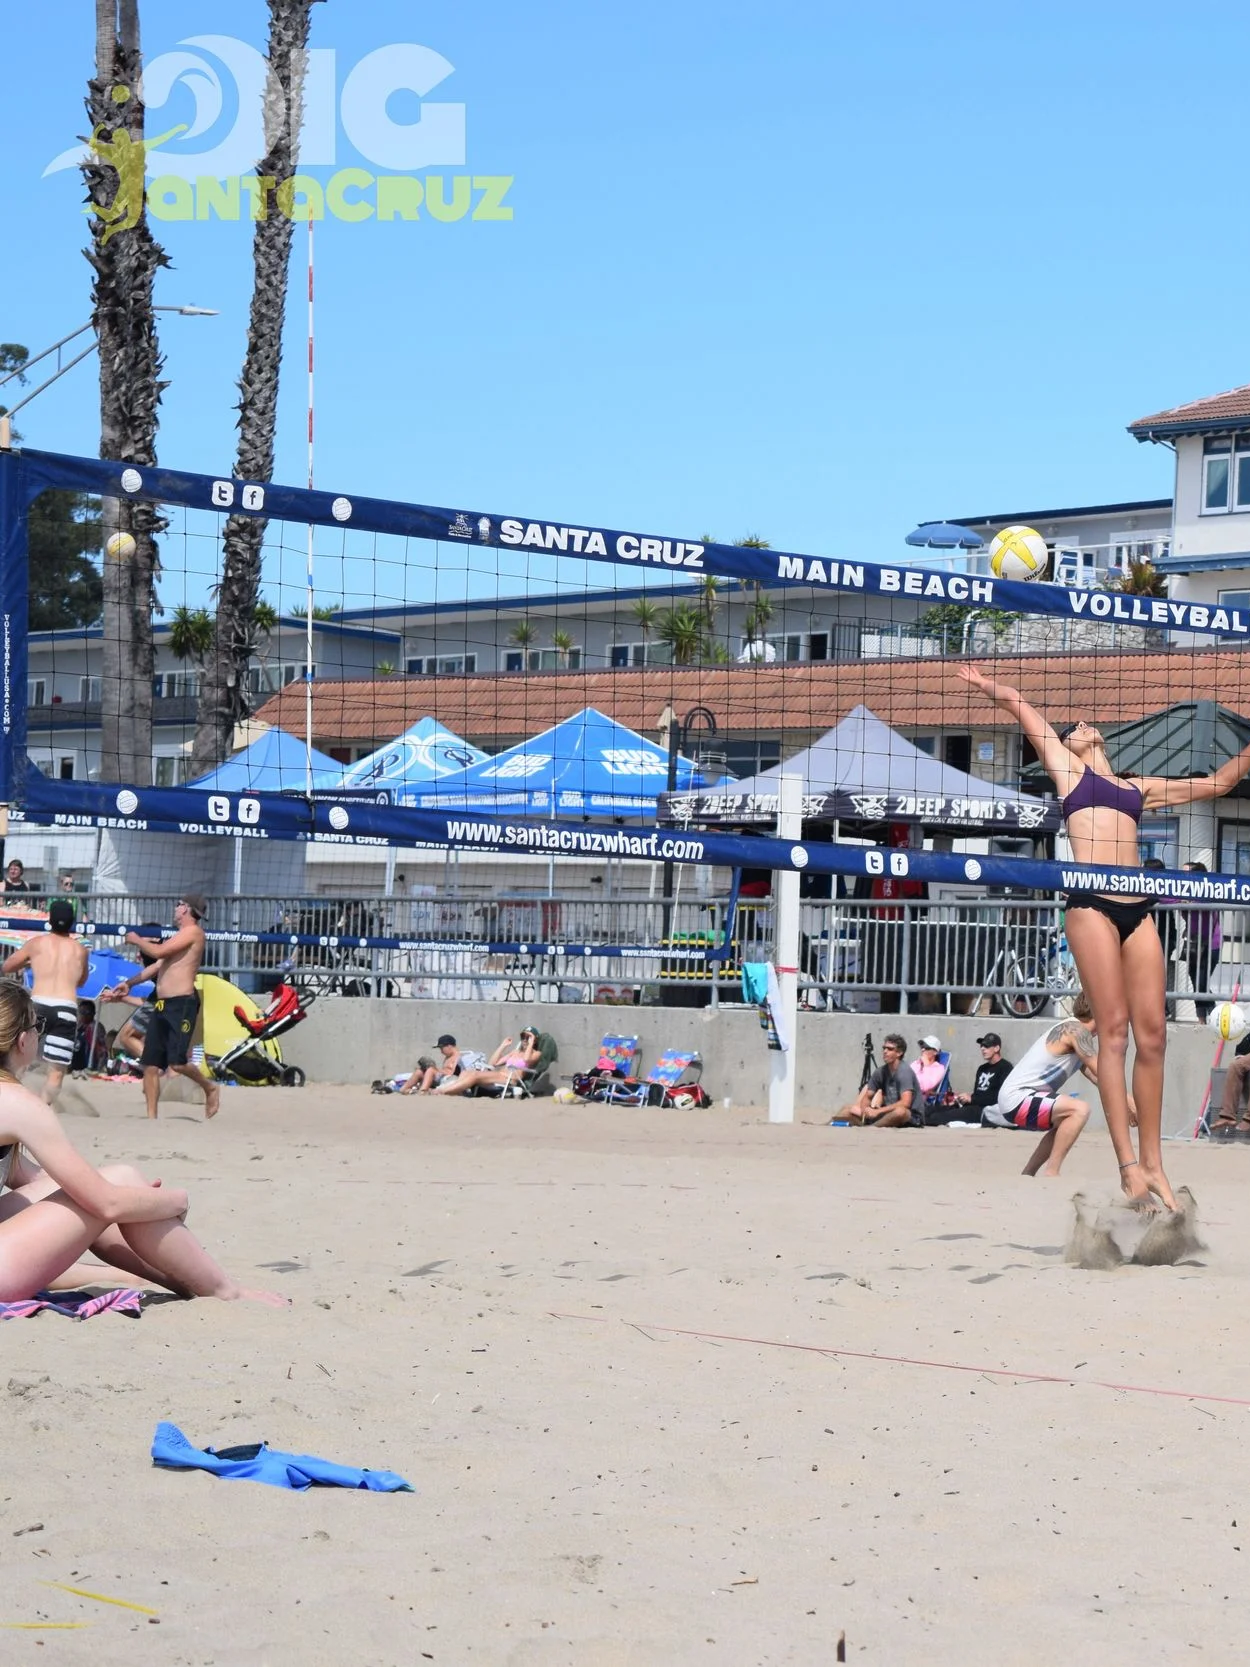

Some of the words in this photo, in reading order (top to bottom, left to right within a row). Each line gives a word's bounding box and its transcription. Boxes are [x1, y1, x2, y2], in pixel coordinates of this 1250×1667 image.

[499, 519, 608, 557] SANTA
[615, 534, 705, 568] CRUZ
[777, 555, 865, 589] MAIN
[879, 567, 995, 604] BEACH
[600, 749, 662, 763] BUD
[894, 795, 946, 816] 2DEEP
[950, 798, 1007, 821] SPORTS
[7, 809, 25, 821] UZ
[54, 813, 92, 828] MAIN
[96, 815, 148, 831] BEACH
[179, 821, 269, 839] VOLLEYBALL
[314, 831, 358, 845] SANTA
[446, 820, 704, 861] www.santacruzwharf.com
